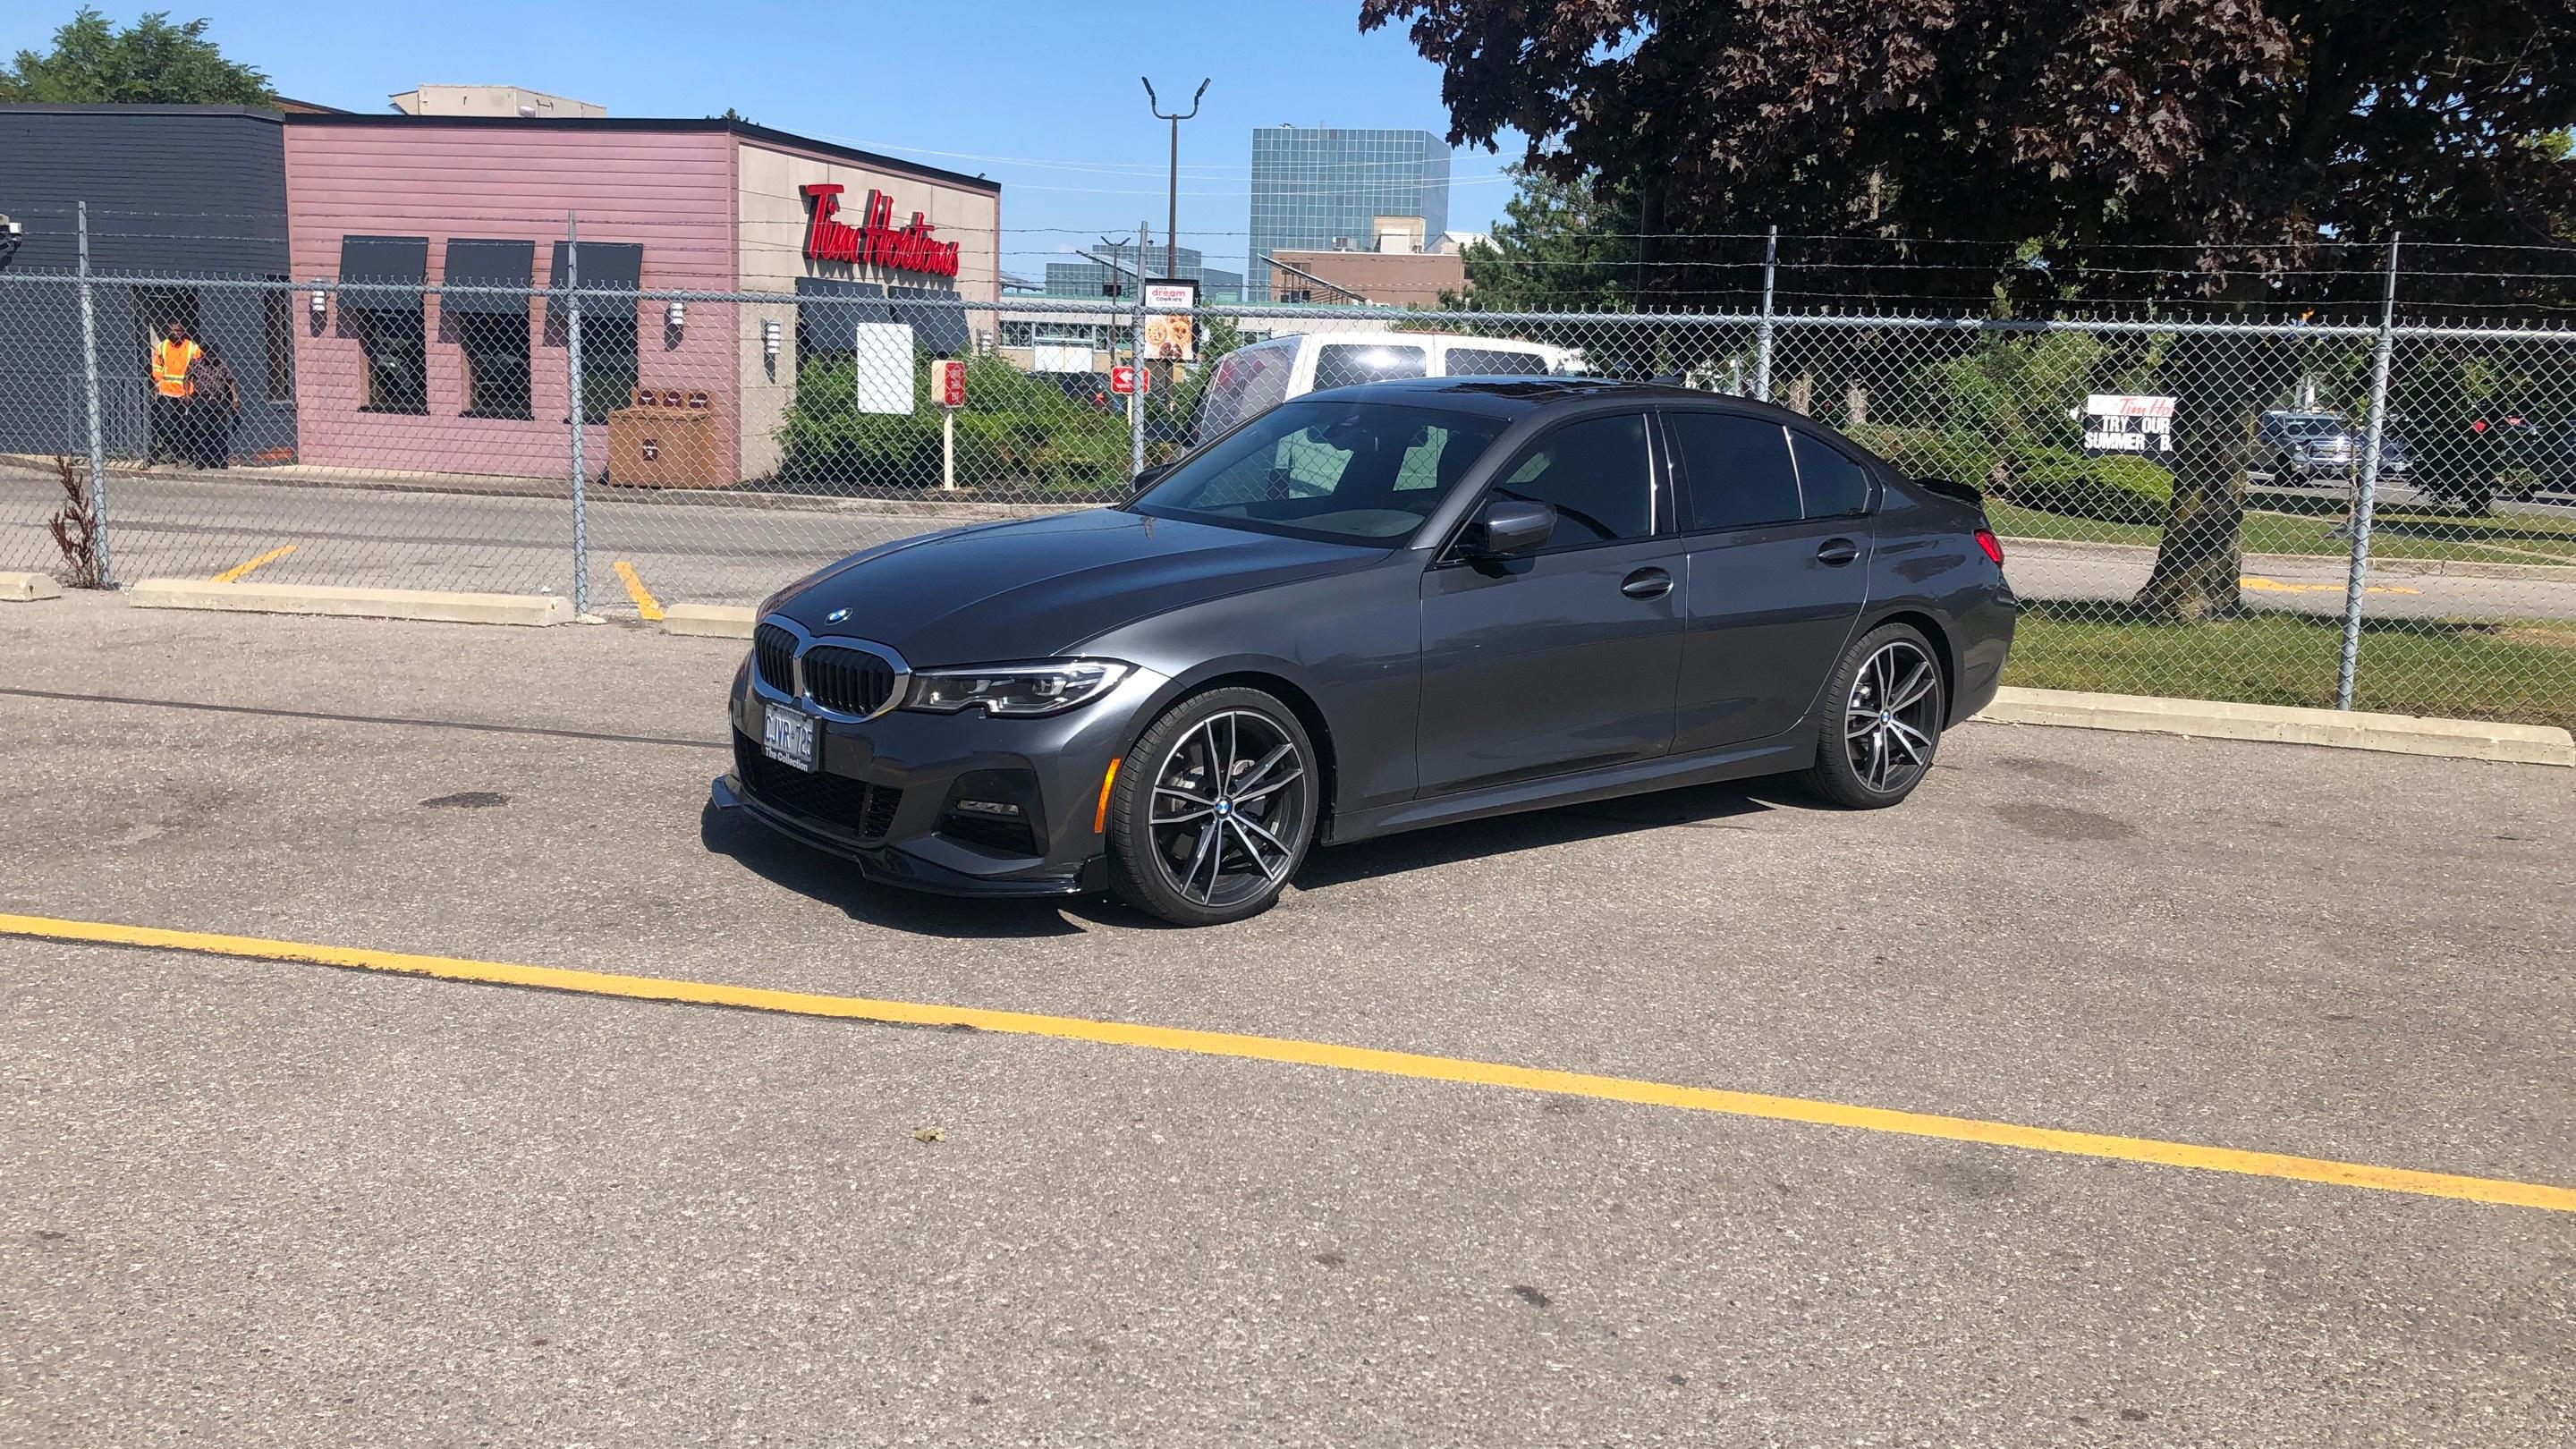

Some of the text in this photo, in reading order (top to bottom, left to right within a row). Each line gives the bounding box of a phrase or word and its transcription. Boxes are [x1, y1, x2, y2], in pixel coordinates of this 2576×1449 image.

[806, 183, 959, 277] Tim Hortons
[1151, 287, 1186, 297] dream
[2119, 398, 2146, 414] Tim
[2101, 415, 2171, 435] TRY OUR
[2083, 431, 2174, 452] SUMMER B
[765, 746, 809, 773] The Collection
